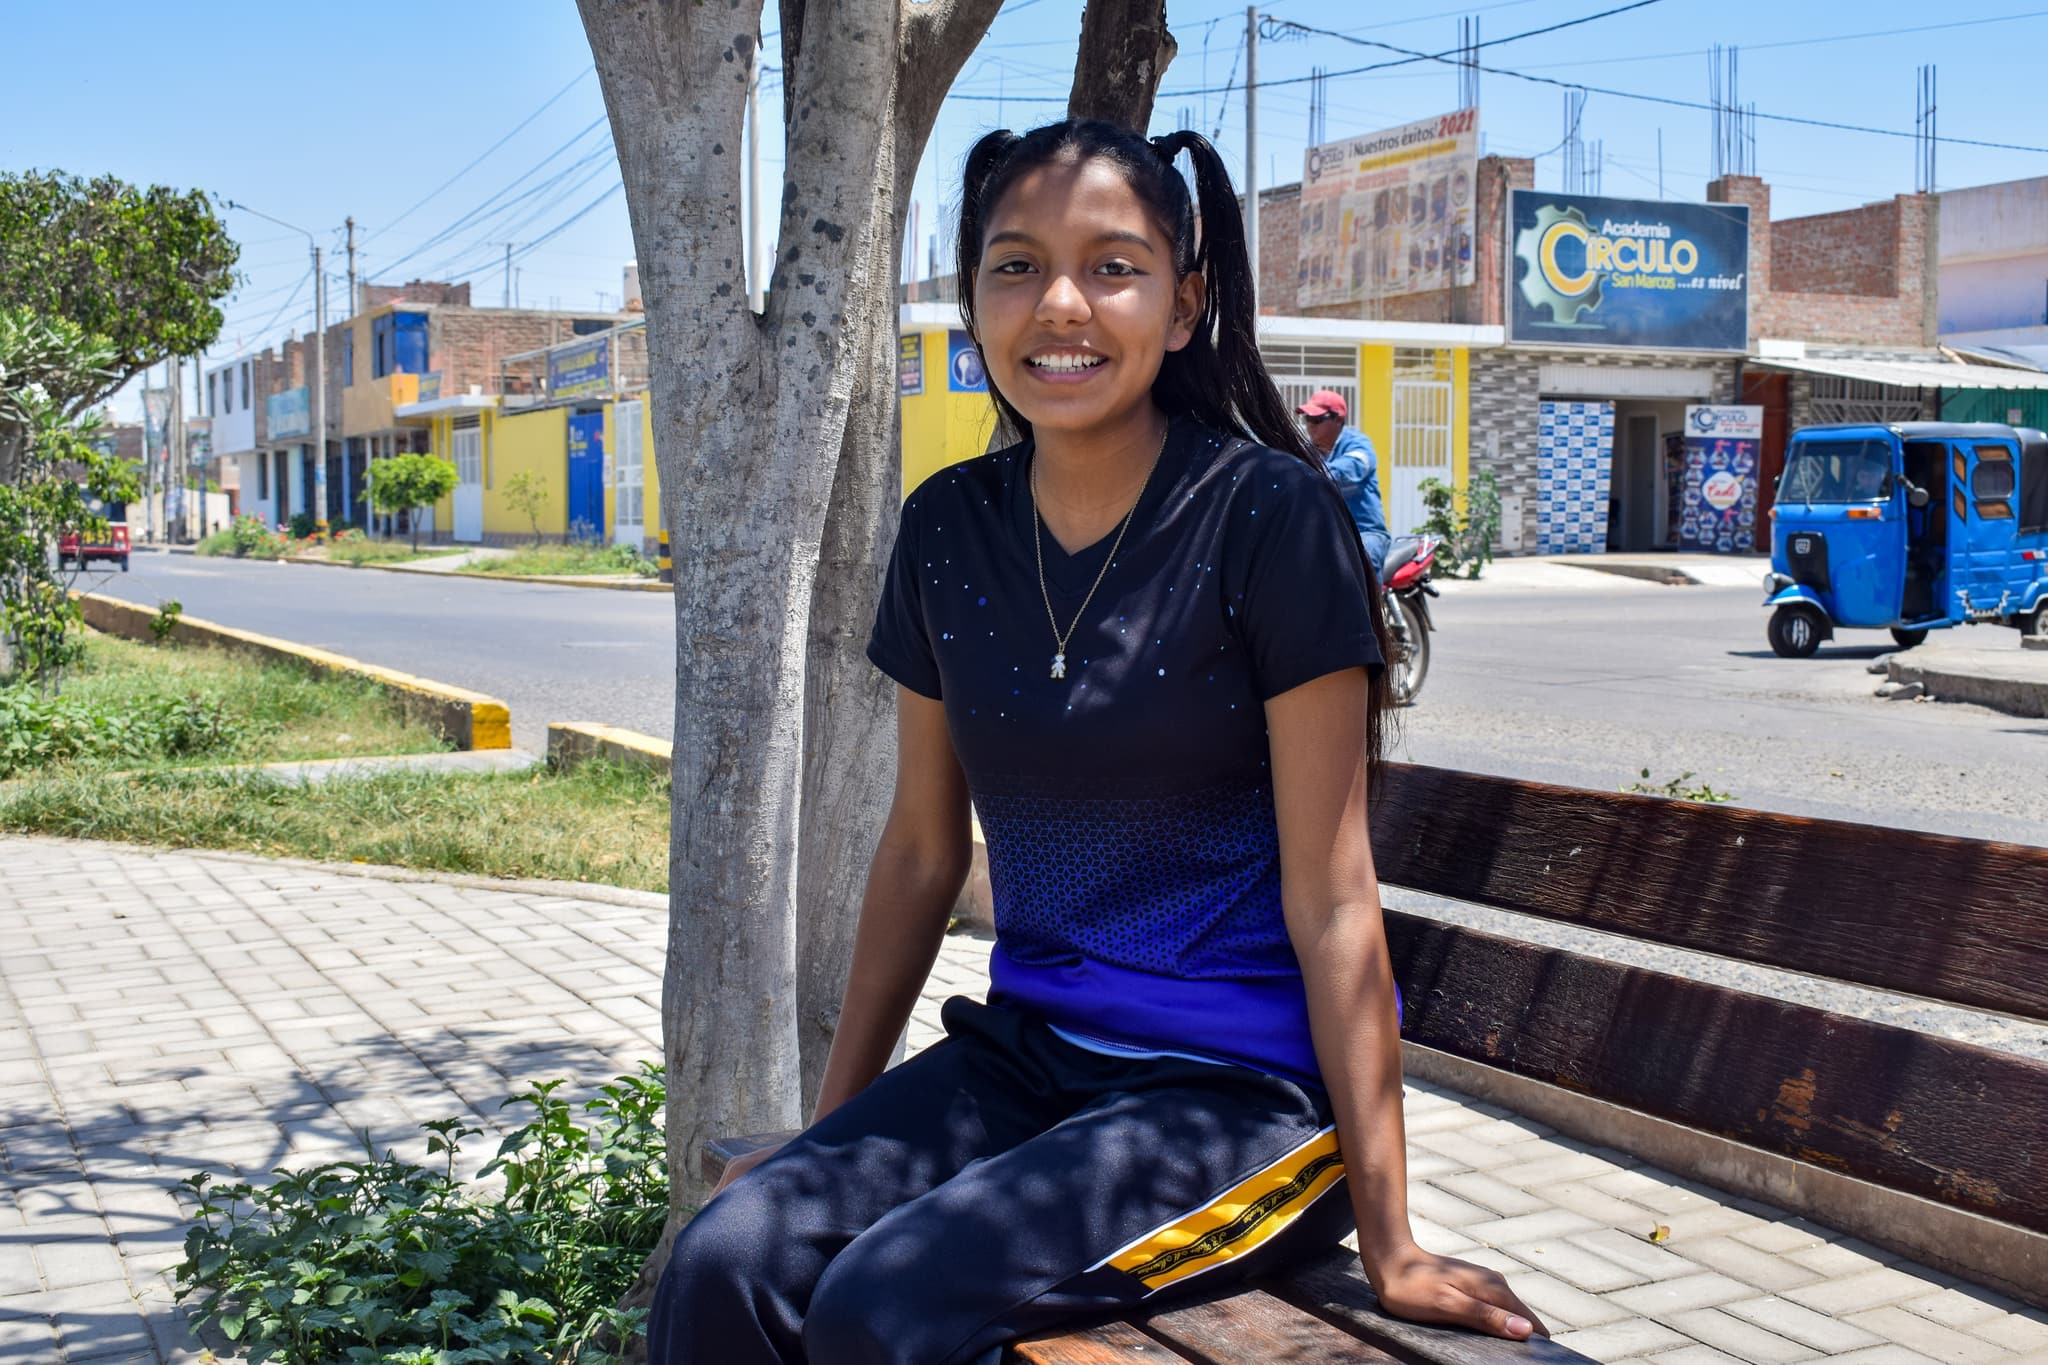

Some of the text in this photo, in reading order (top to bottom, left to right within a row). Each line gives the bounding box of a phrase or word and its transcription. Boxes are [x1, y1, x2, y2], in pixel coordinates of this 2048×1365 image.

[1438, 109, 1475, 138] 2021
[1602, 218, 1671, 239] Academia
[1611, 271, 1634, 289] San
[1636, 273, 1676, 290] Marcos
[1708, 273, 1745, 290] nivel
